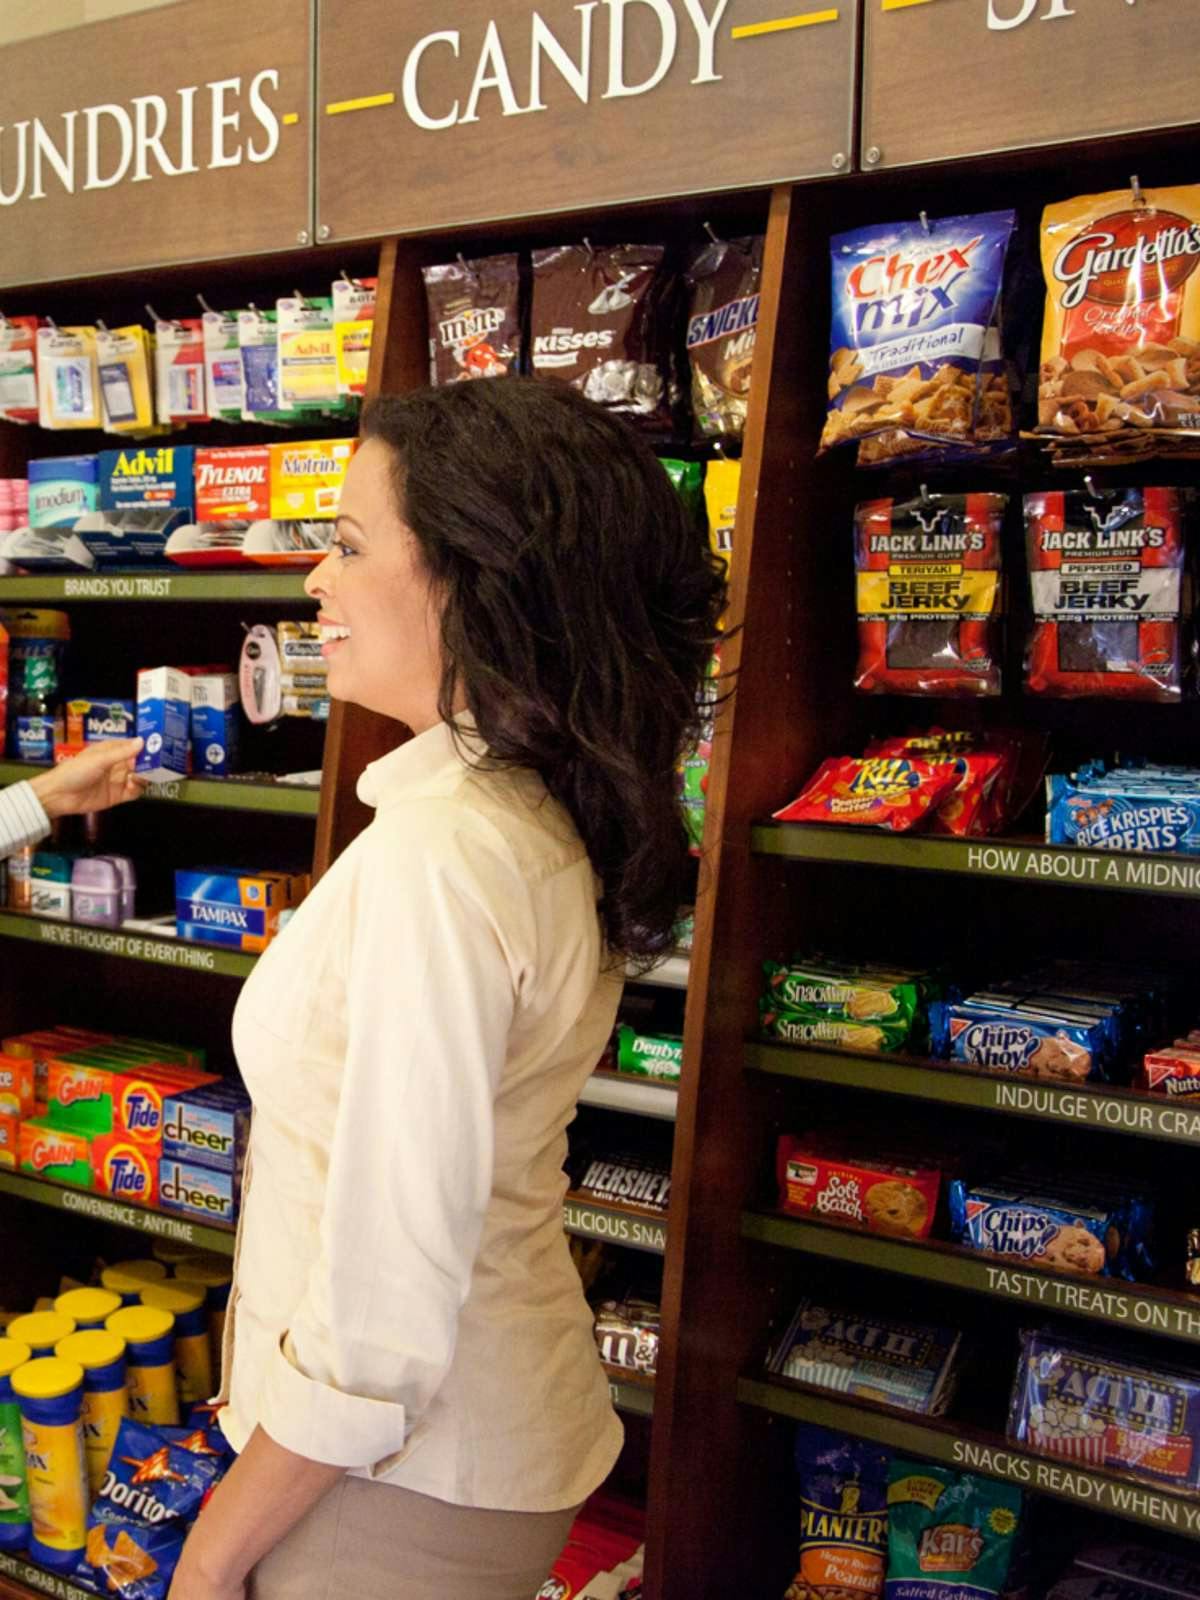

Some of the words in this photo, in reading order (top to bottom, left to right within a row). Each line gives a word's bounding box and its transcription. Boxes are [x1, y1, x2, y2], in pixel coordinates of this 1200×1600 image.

[401, 0, 729, 131] CANDY
[847, 236, 984, 299] Chex
[871, 327, 965, 361] Traditional
[112, 447, 175, 477] Advil
[197, 464, 266, 486] TYLENOL
[284, 456, 337, 474] Motrin
[870, 535, 916, 552] JACK
[921, 532, 984, 552] LINK'S
[1042, 530, 1091, 550] JACK
[1097, 527, 1164, 549] LINK'S
[900, 565, 952, 574] TERIYAKI
[1068, 564, 1133, 572] PEPPERED
[64, 579, 109, 597] BRANDS
[111, 579, 134, 596] YOU
[136, 578, 172, 596] TRUST
[888, 581, 961, 595] BEEF
[1059, 579, 1140, 594] BEEF
[880, 595, 972, 611] JERKY
[1054, 594, 1150, 611] JERKY
[1077, 819, 1110, 847] RICE
[1110, 806, 1189, 833] KRISPIES
[968, 847, 1025, 873] HOW
[1026, 851, 1100, 879] ABOUT
[1104, 859, 1120, 881] A
[190, 904, 249, 929] TAMPAX
[73, 930, 123, 953] THOUGHT
[123, 938, 142, 956] OF
[144, 941, 215, 970] EVERYTHING
[966, 1026, 1032, 1050] Chips
[970, 1037, 1041, 1072] Ahoy!
[126, 1095, 160, 1130] Tide
[995, 1083, 1088, 1120] INDULGE
[1091, 1099, 1153, 1129] YOUR
[163, 1105, 233, 1152] cheer
[109, 1159, 145, 1193] Tide
[160, 1165, 230, 1213] cheer
[826, 1176, 859, 1201] Soft
[62, 1192, 136, 1226] CONVENIENCE
[143, 1216, 194, 1242] ANYTIME
[816, 1191, 863, 1222] Batch
[984, 1210, 1047, 1238] Chips
[988, 1225, 1059, 1259] Ahoy!
[986, 1267, 1049, 1299] TASTY
[1052, 1282, 1129, 1319] TREATS
[1134, 1301, 1169, 1328] ON
[952, 1440, 1031, 1481] SNACKS
[1036, 1465, 1107, 1502] READY
[1110, 1483, 1179, 1523] WHEN
[25, 1567, 56, 1592] GRAB
[56, 1580, 66, 1598] A
